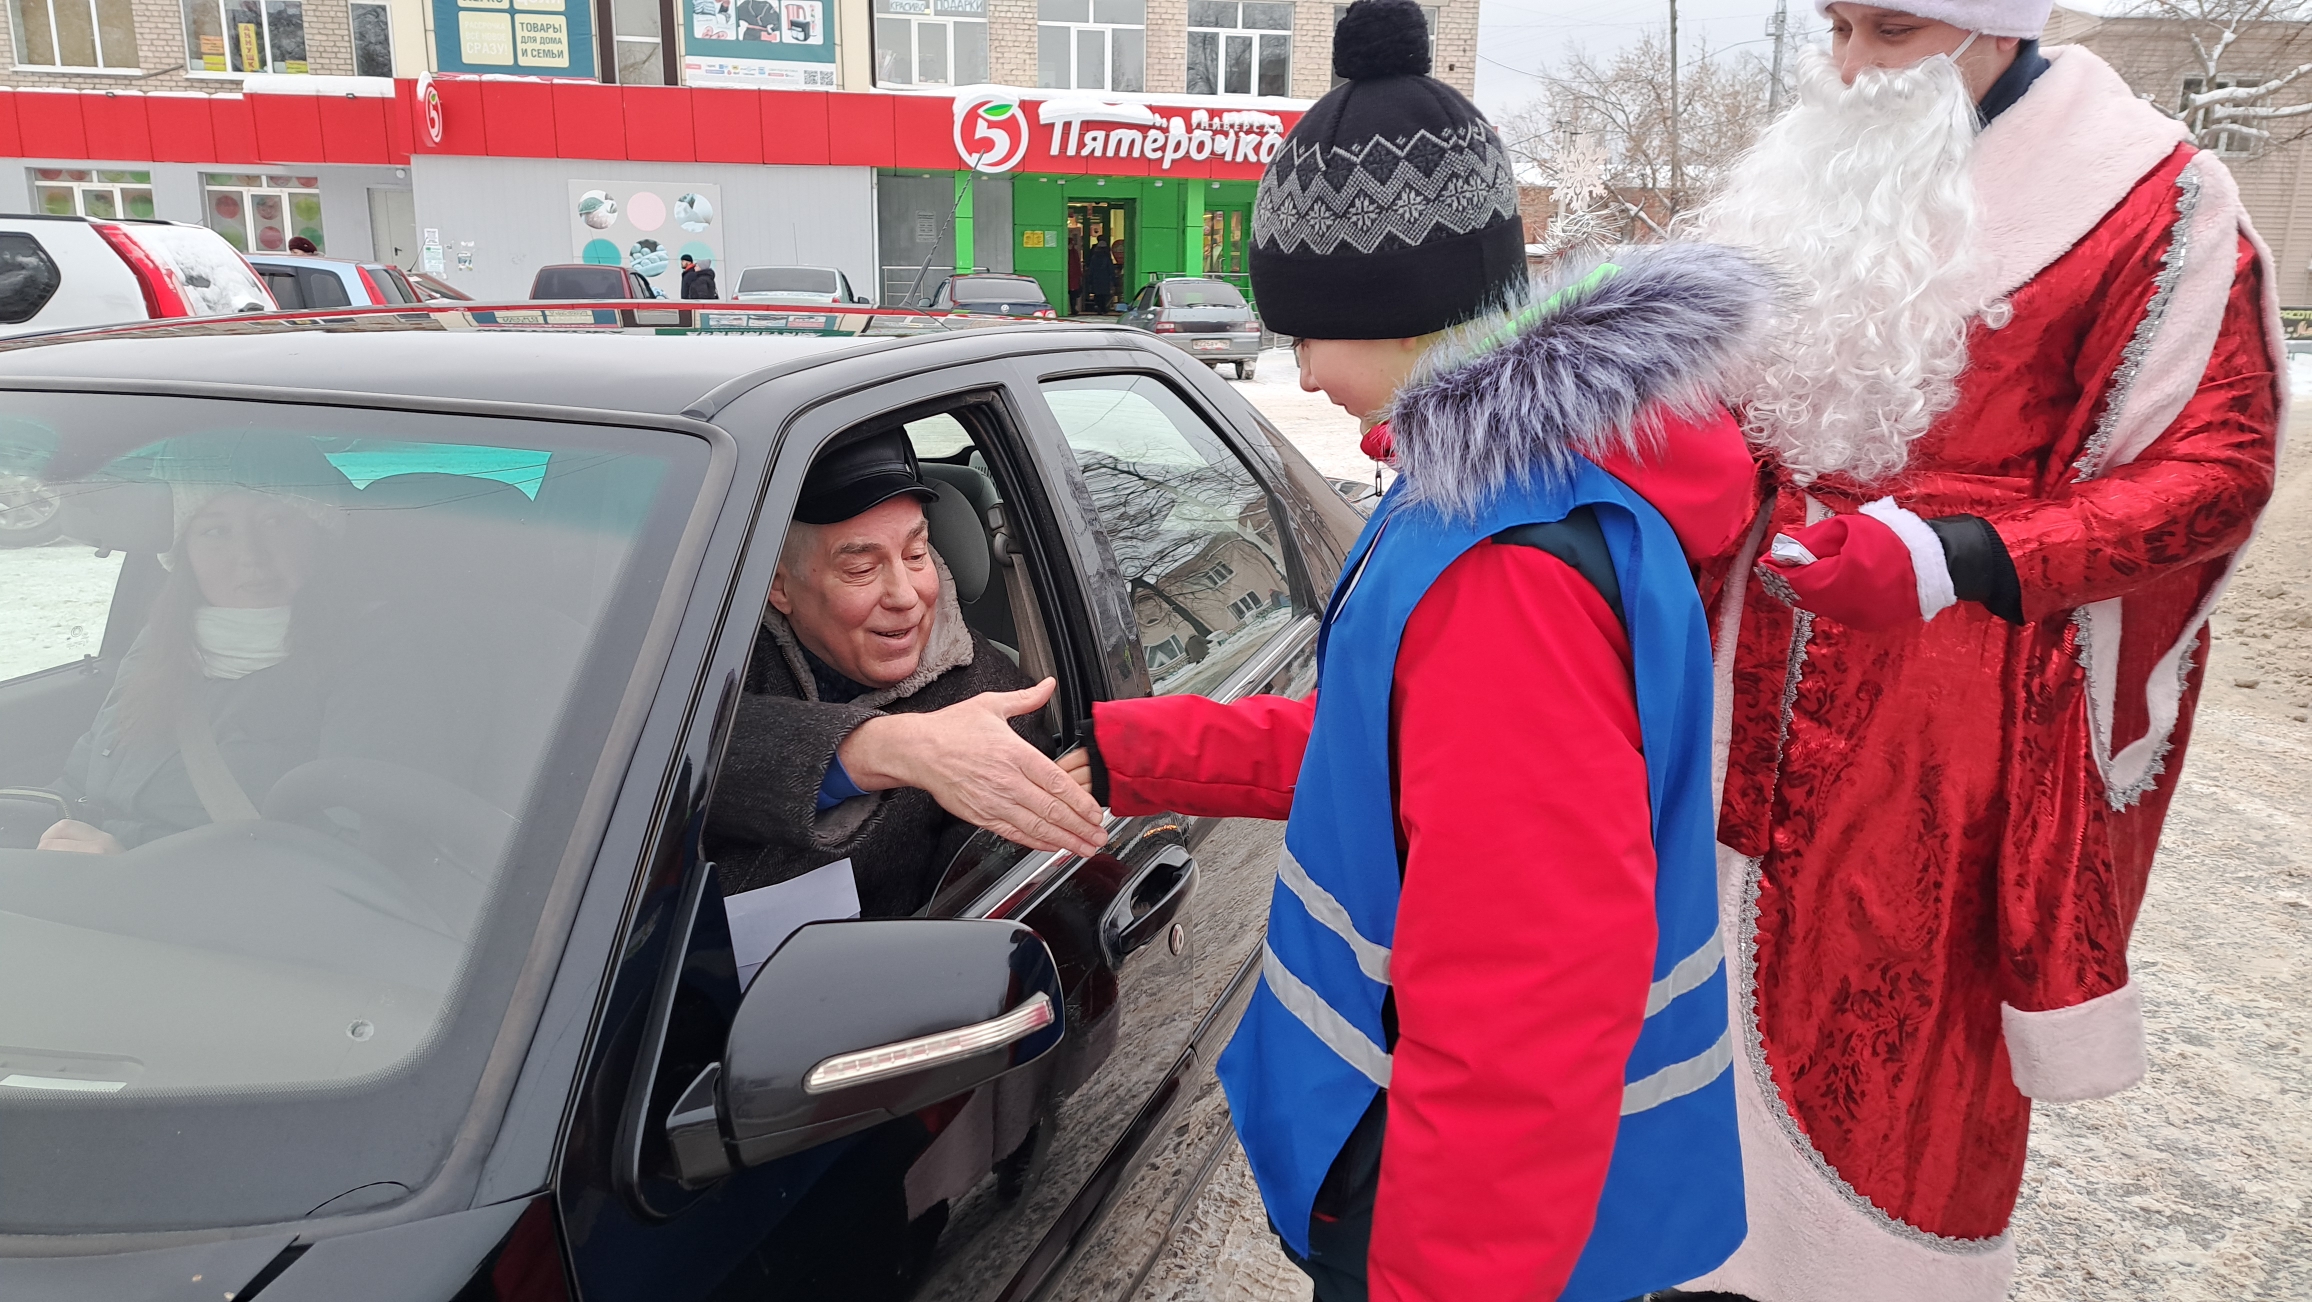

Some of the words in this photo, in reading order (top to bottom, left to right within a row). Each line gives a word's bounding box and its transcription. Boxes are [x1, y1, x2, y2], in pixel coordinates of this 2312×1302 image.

[519, 22, 562, 34] ТОВАРЫ
[520, 36, 538, 45] ДЛЯ
[539, 36, 563, 46] ДОМА
[243, 24, 256, 73] АННУШК
[466, 42, 508, 56] СРАЗУ!
[521, 48, 529, 58] И
[530, 48, 564, 60] СЕМЬИ
